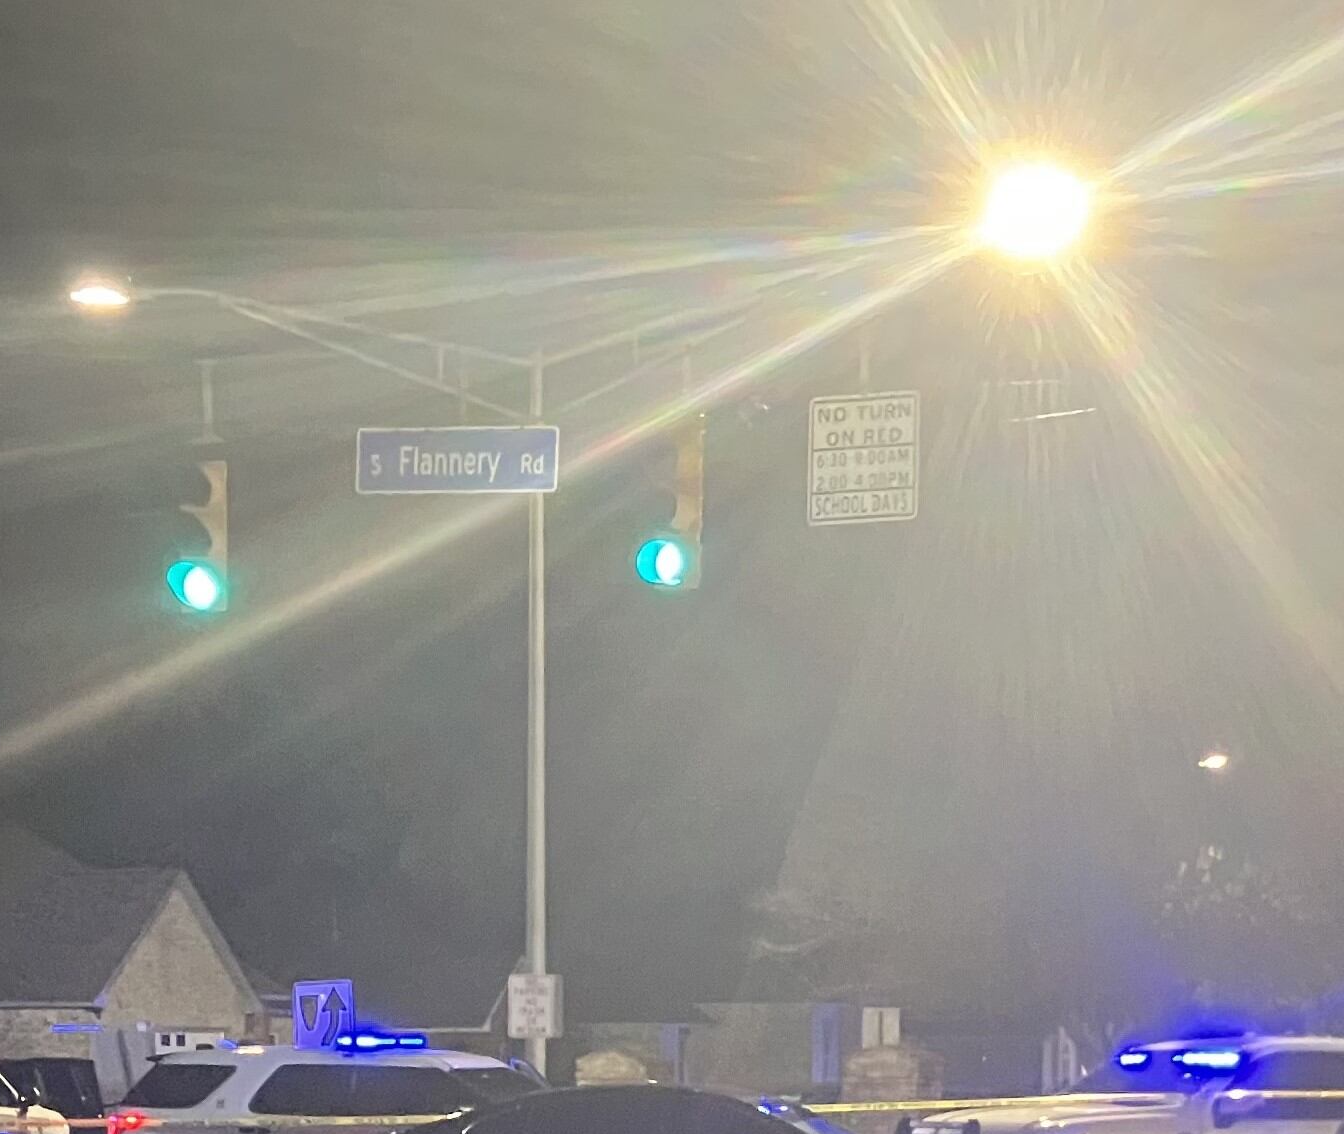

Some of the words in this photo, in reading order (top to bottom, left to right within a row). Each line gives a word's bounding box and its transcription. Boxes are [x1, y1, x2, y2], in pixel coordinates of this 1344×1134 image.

[817, 407, 846, 423] NO
[856, 403, 912, 421] TURN
[826, 430, 854, 447] ON
[863, 427, 903, 444] RED
[370, 453, 382, 477] S
[398, 445, 502, 484] Flannery
[519, 453, 545, 475] Rd
[815, 495, 868, 516] SCHOOL
[871, 491, 908, 513] DAYS
